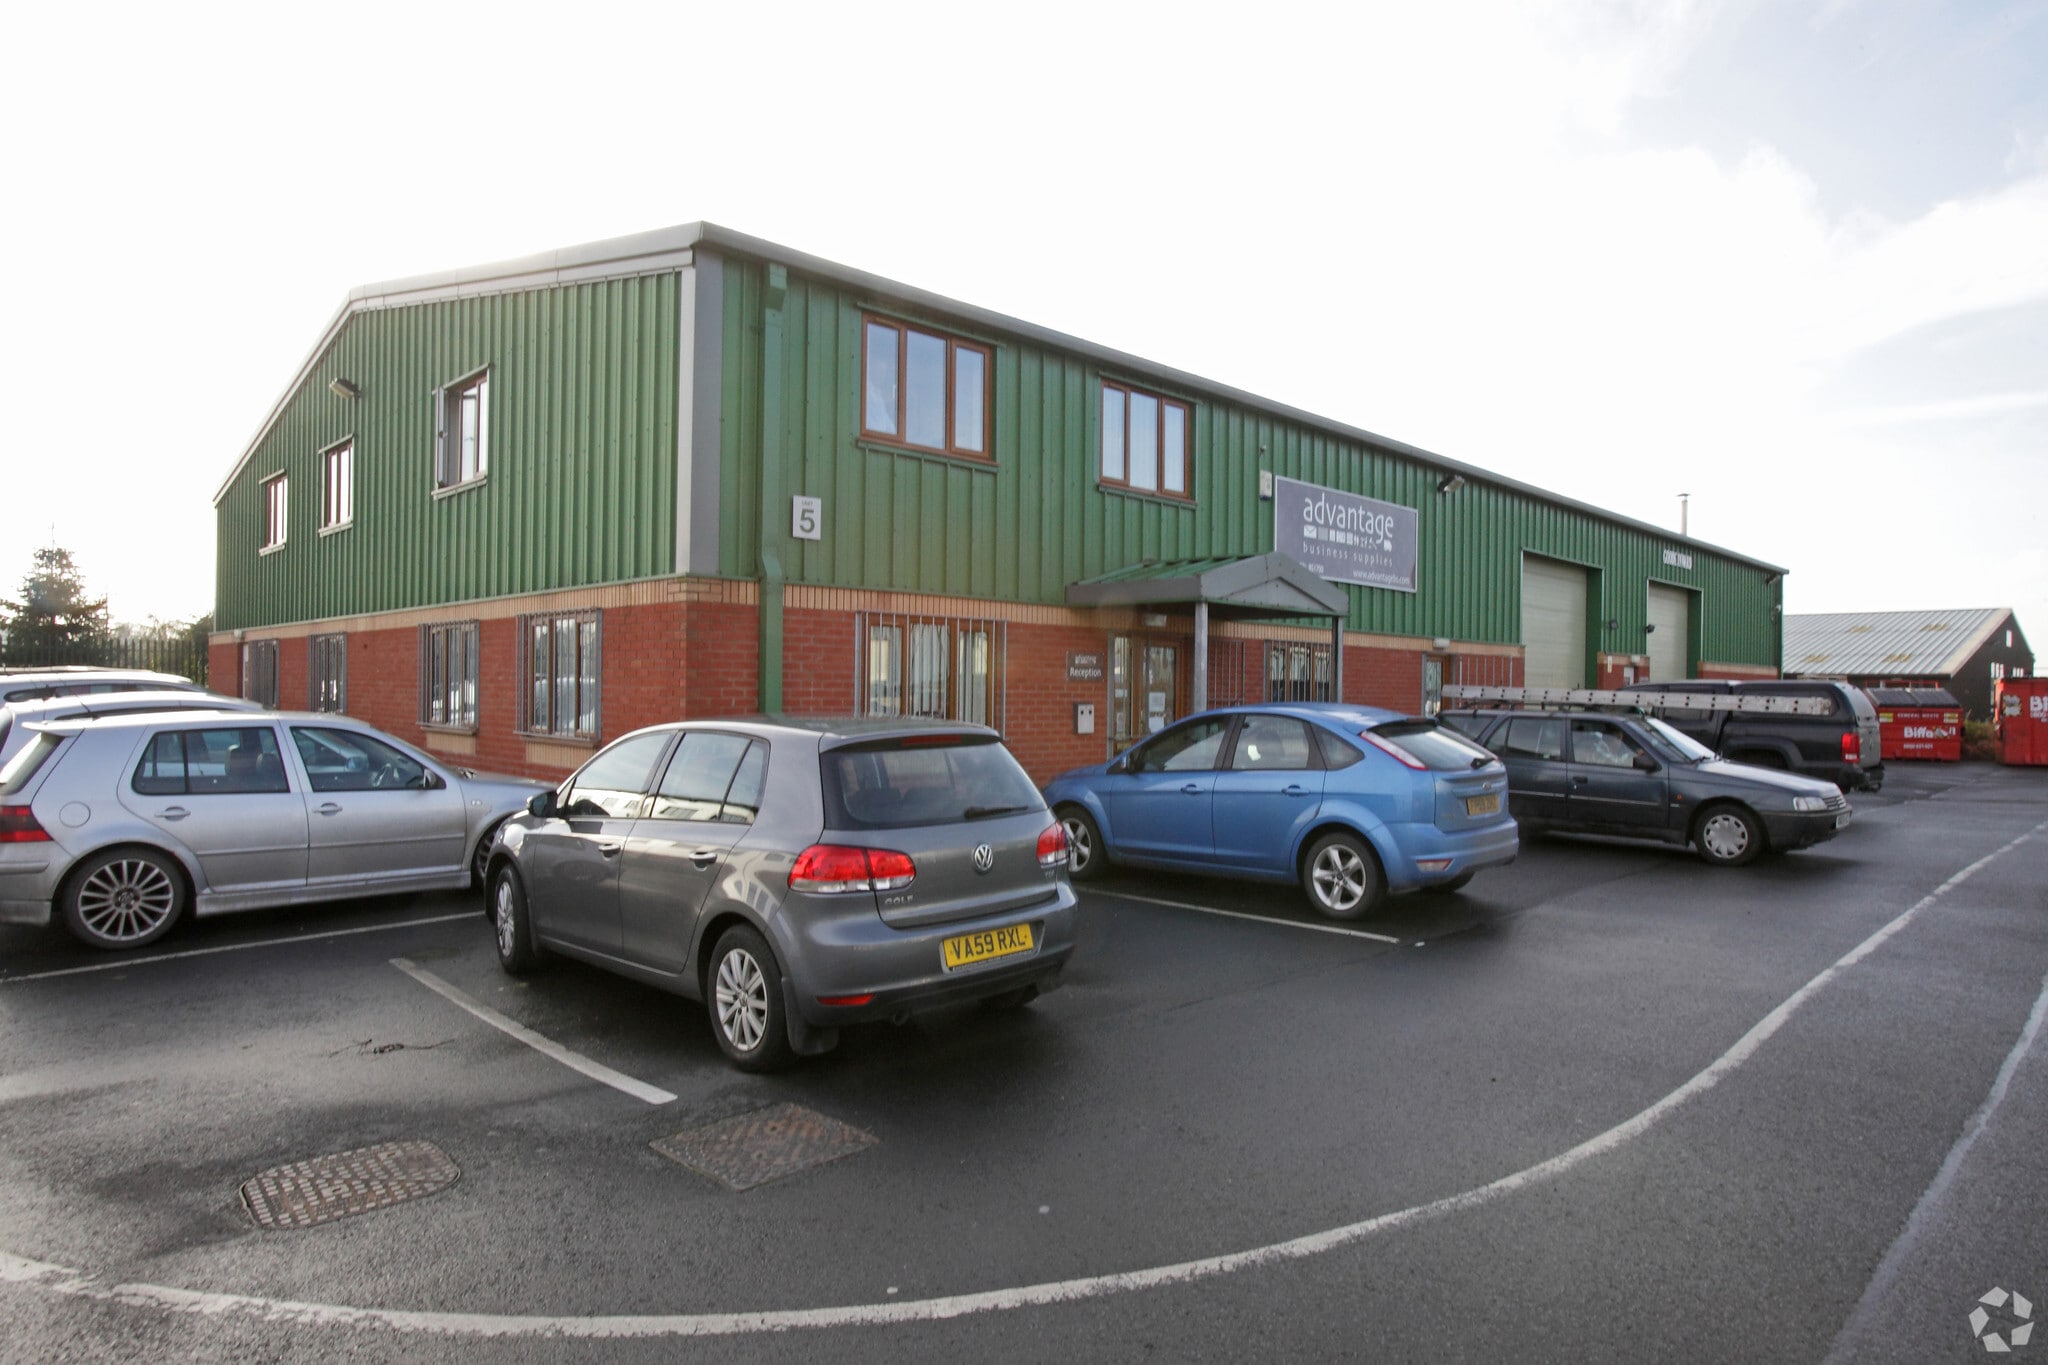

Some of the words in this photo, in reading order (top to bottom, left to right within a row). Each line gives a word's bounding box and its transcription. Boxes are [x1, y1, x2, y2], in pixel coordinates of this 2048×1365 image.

[800, 508, 815, 533] 5
[1303, 492, 1394, 544] advantage
[1303, 541, 1348, 559] business
[1353, 552, 1393, 567] supplies
[1069, 667, 1102, 679] Reception
[1904, 726, 1934, 738] Biffa
[884, 895, 914, 904] GOLF
[951, 933, 995, 959] VA59
[997, 927, 1026, 950] RXL
